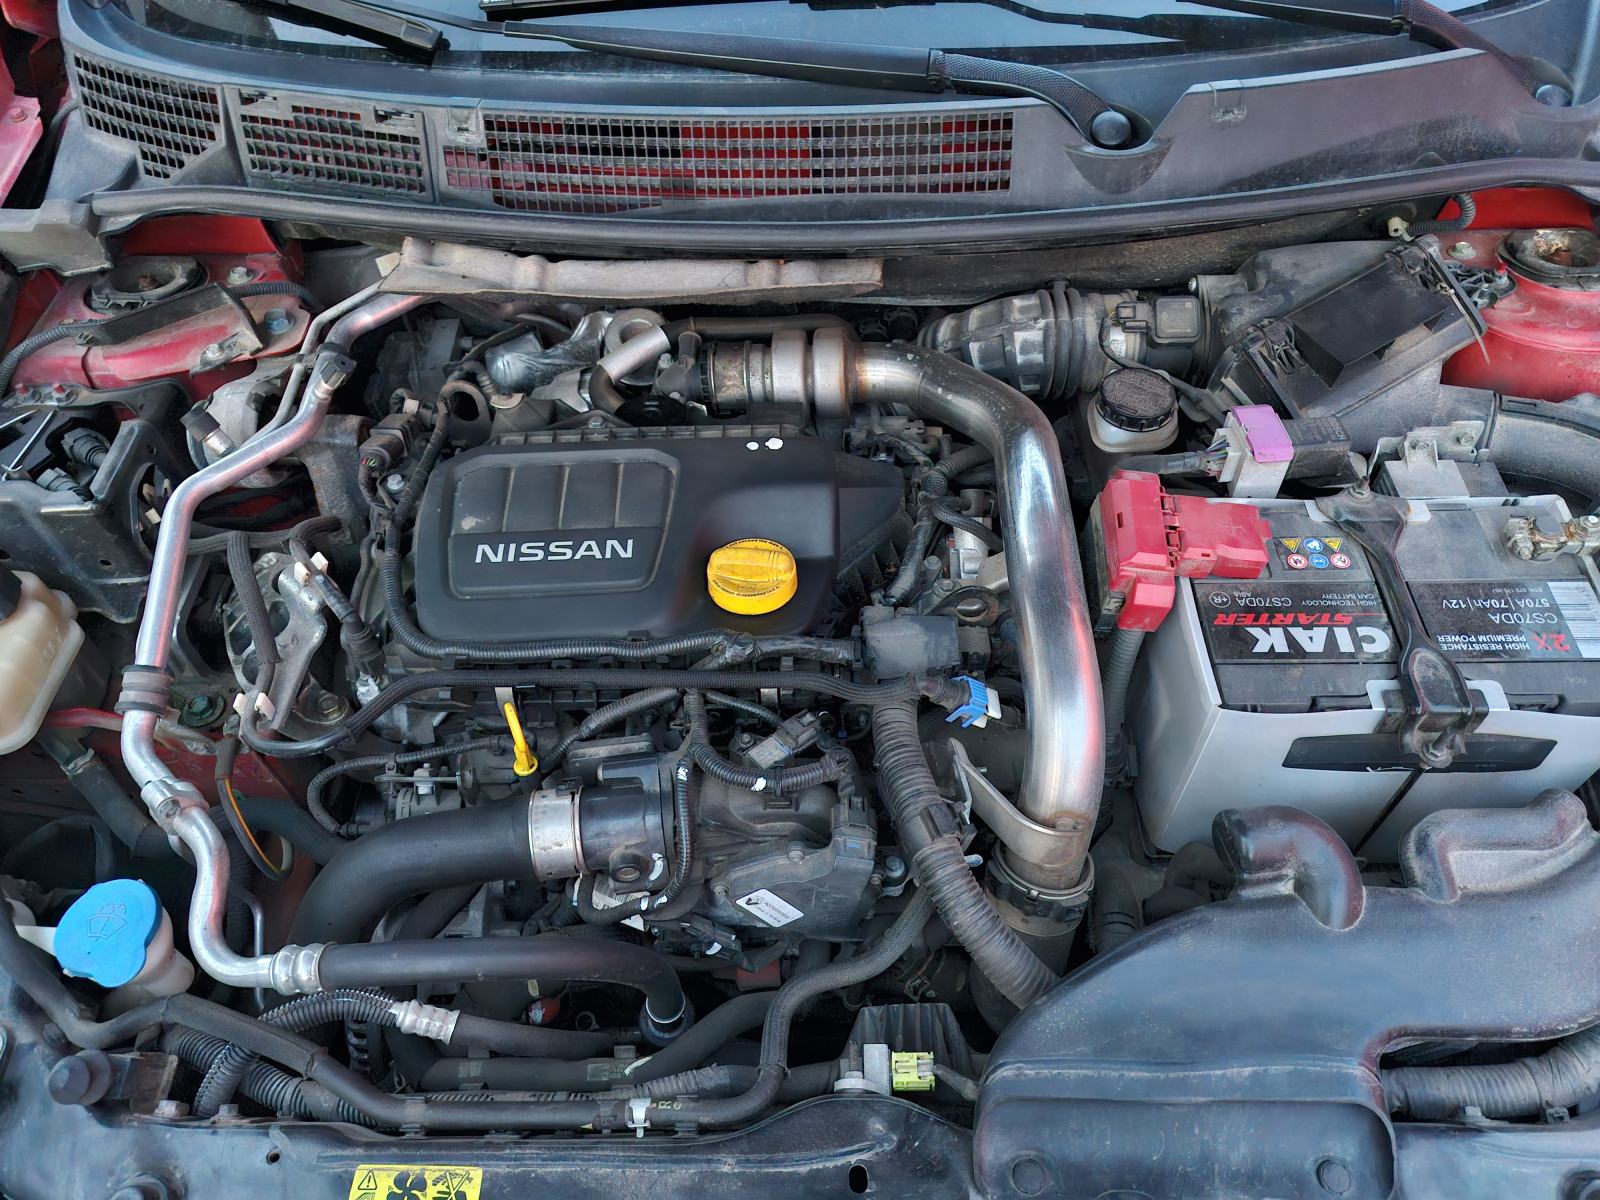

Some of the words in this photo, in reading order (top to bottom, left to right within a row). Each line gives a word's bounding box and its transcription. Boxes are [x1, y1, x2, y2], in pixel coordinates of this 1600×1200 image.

[474, 538, 634, 564] NISSAN
[1234, 596, 1292, 606] CS70DA
[1213, 612, 1353, 625] STARTER
[1487, 612, 1558, 624] CS70DA
[1243, 626, 1391, 653] CIAK
[1437, 634, 1474, 642] POWER
[1478, 634, 1526, 642] PREMIUM
[1534, 633, 1569, 652] 2X
[1504, 642, 1530, 650] HIGH
